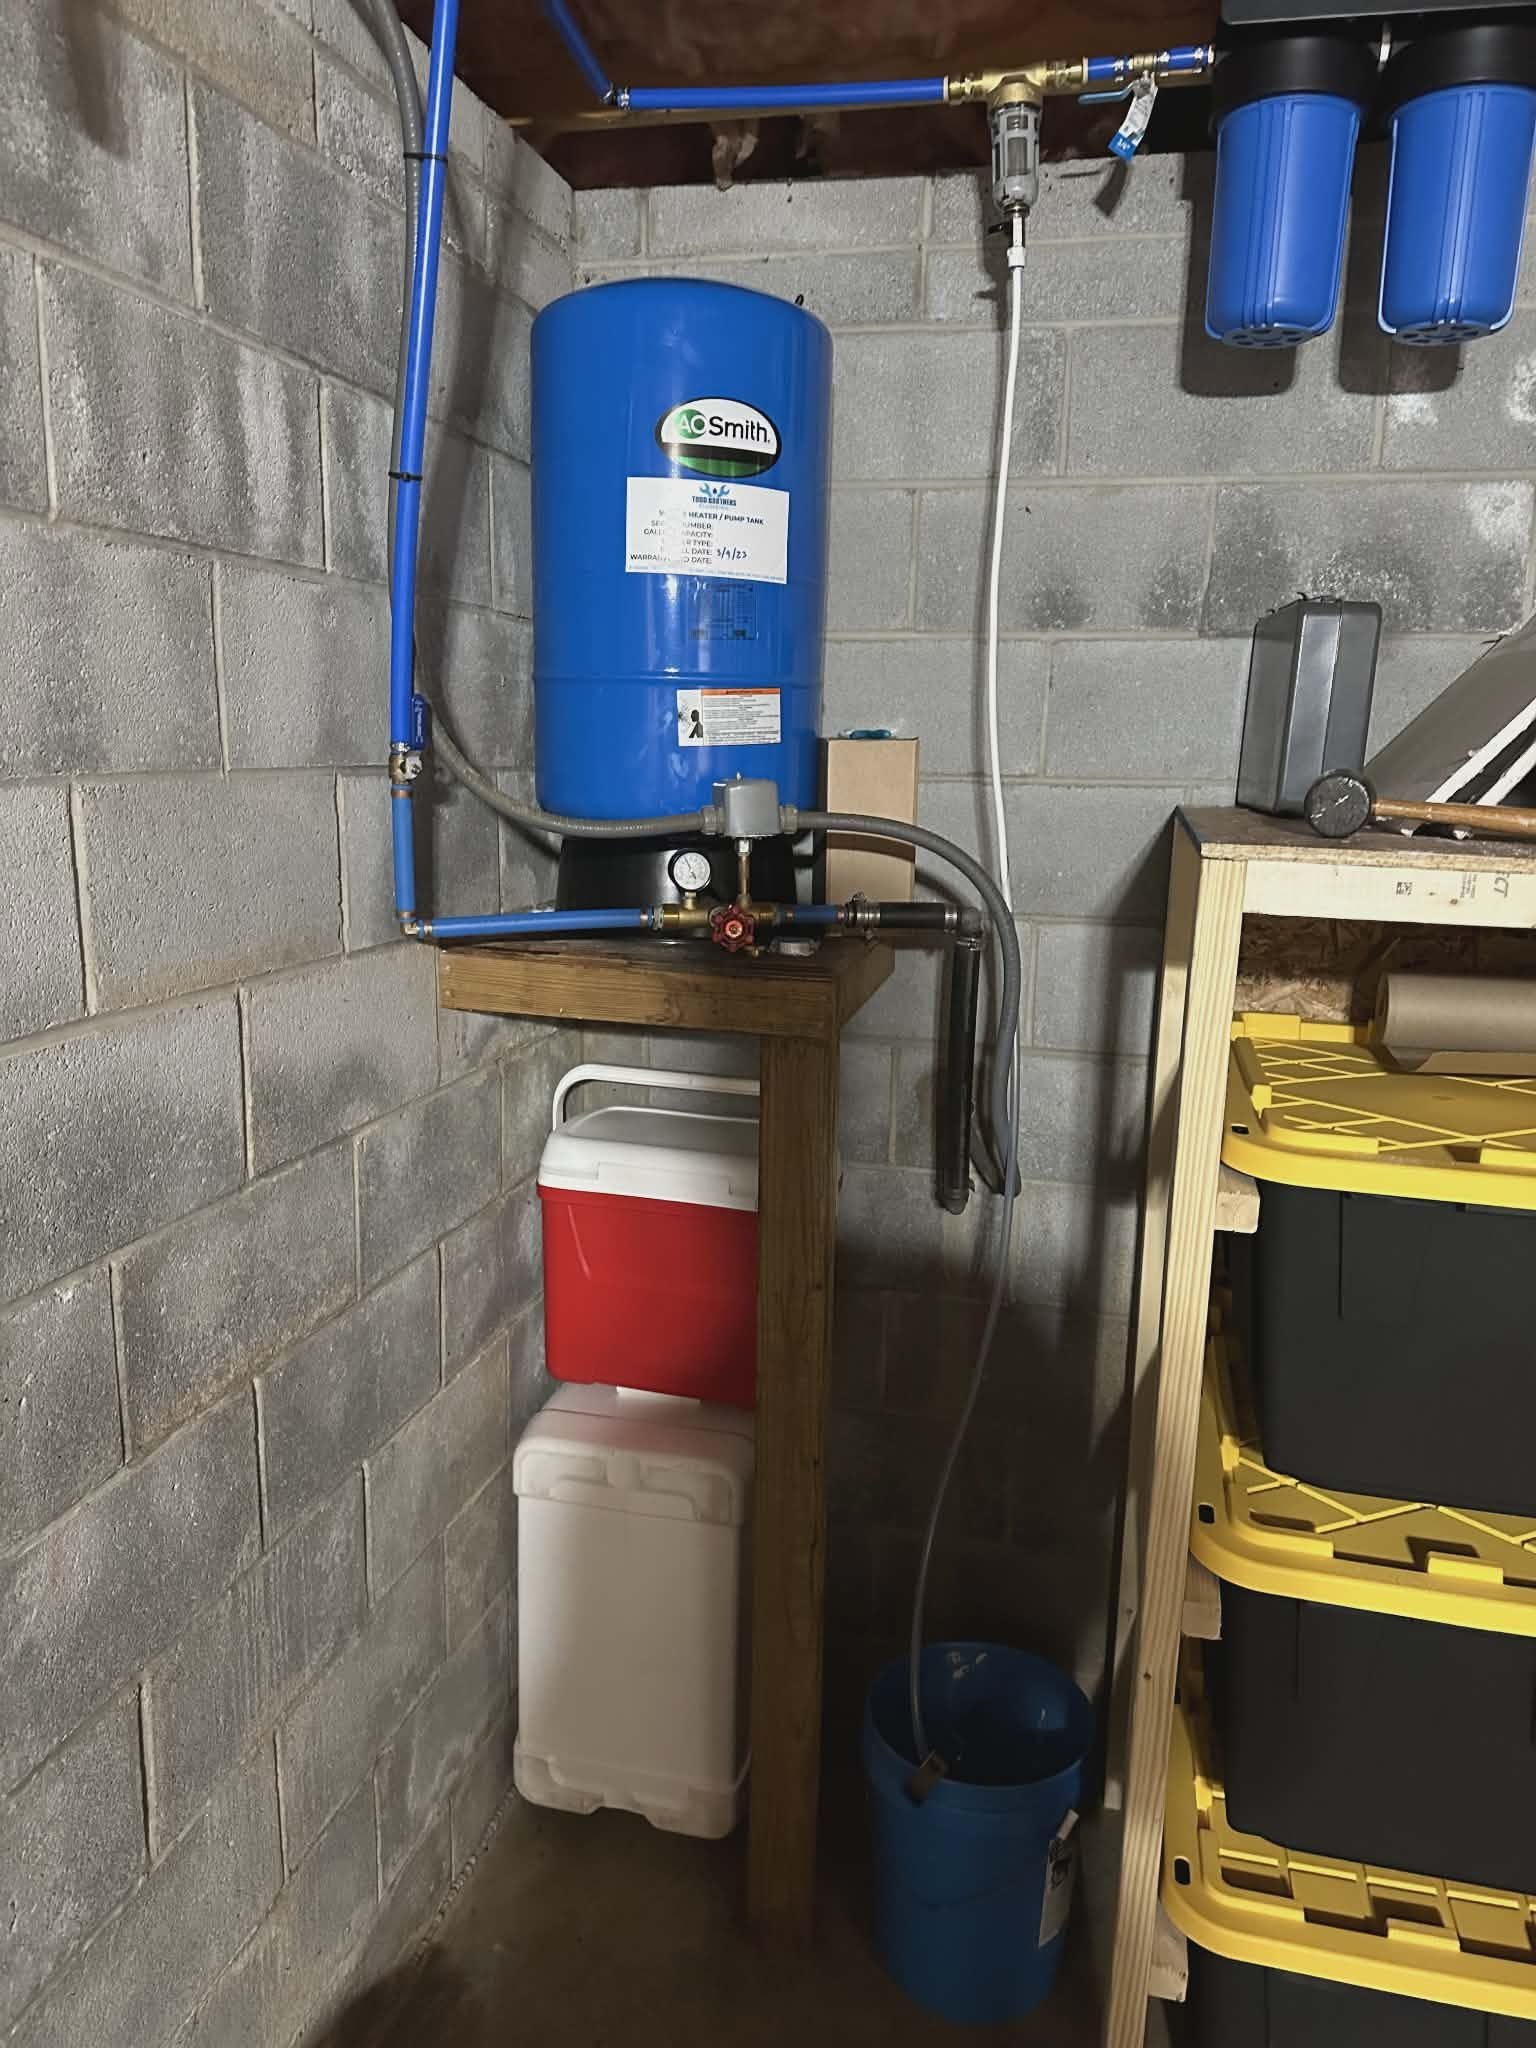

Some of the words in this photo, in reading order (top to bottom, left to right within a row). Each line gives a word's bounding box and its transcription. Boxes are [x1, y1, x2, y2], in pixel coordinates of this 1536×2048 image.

[708, 415, 767, 443] Smith
[688, 512, 718, 520] HEATER
[746, 517, 764, 525] TANK
[693, 539, 713, 548] TYPE:
[691, 548, 713, 556] DATE:
[691, 557, 713, 565] DATE:
